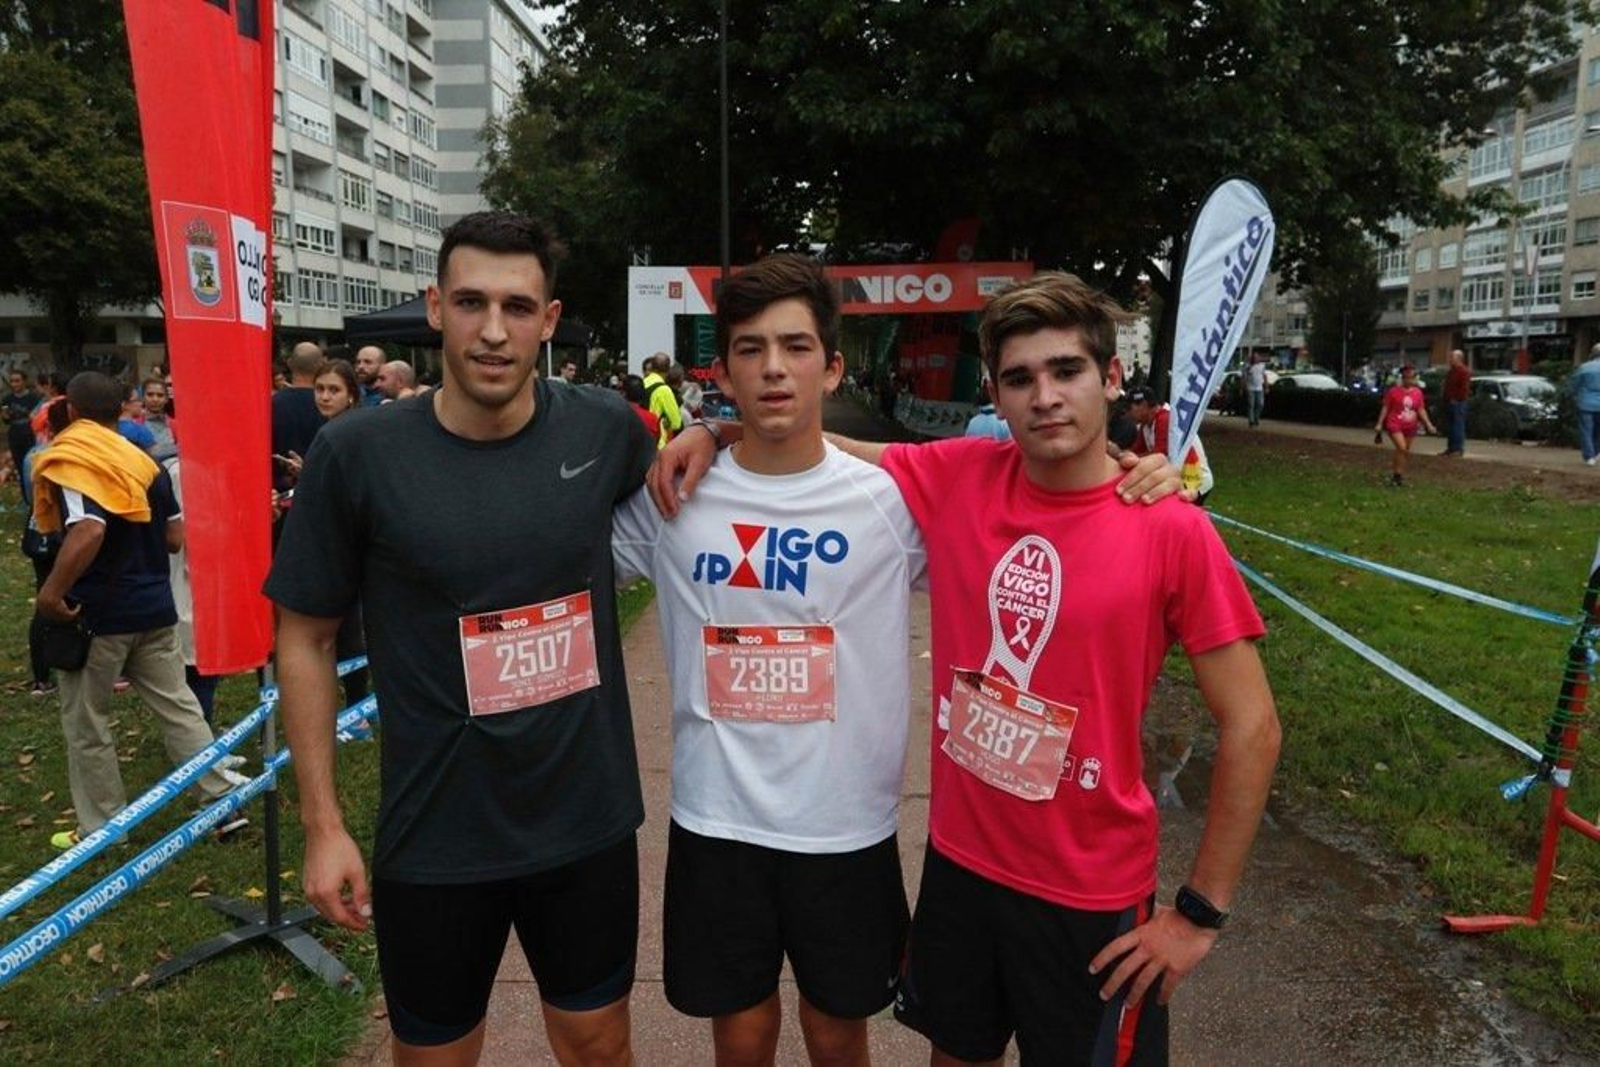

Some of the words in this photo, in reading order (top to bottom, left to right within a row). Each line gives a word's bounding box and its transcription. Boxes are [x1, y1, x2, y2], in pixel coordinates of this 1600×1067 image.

[857, 273, 953, 304] VIGO
[1175, 215, 1265, 434] Atlántico
[1024, 547, 1046, 570] VI
[997, 587, 1034, 605] CONTRA
[1036, 598, 1050, 609] EL
[1003, 572, 1049, 597] VIGO
[496, 629, 573, 682] 2507
[730, 657, 809, 693] 2389
[963, 702, 1041, 765] 2387
[43, 828, 110, 875] DECATHLON
[110, 786, 169, 827] DECATHLON
[169, 747, 218, 785] DECATHLON
[132, 835, 185, 880] DECATHLON
[66, 875, 128, 927] DECATHLON
[0, 923, 60, 976] DECATHLO
